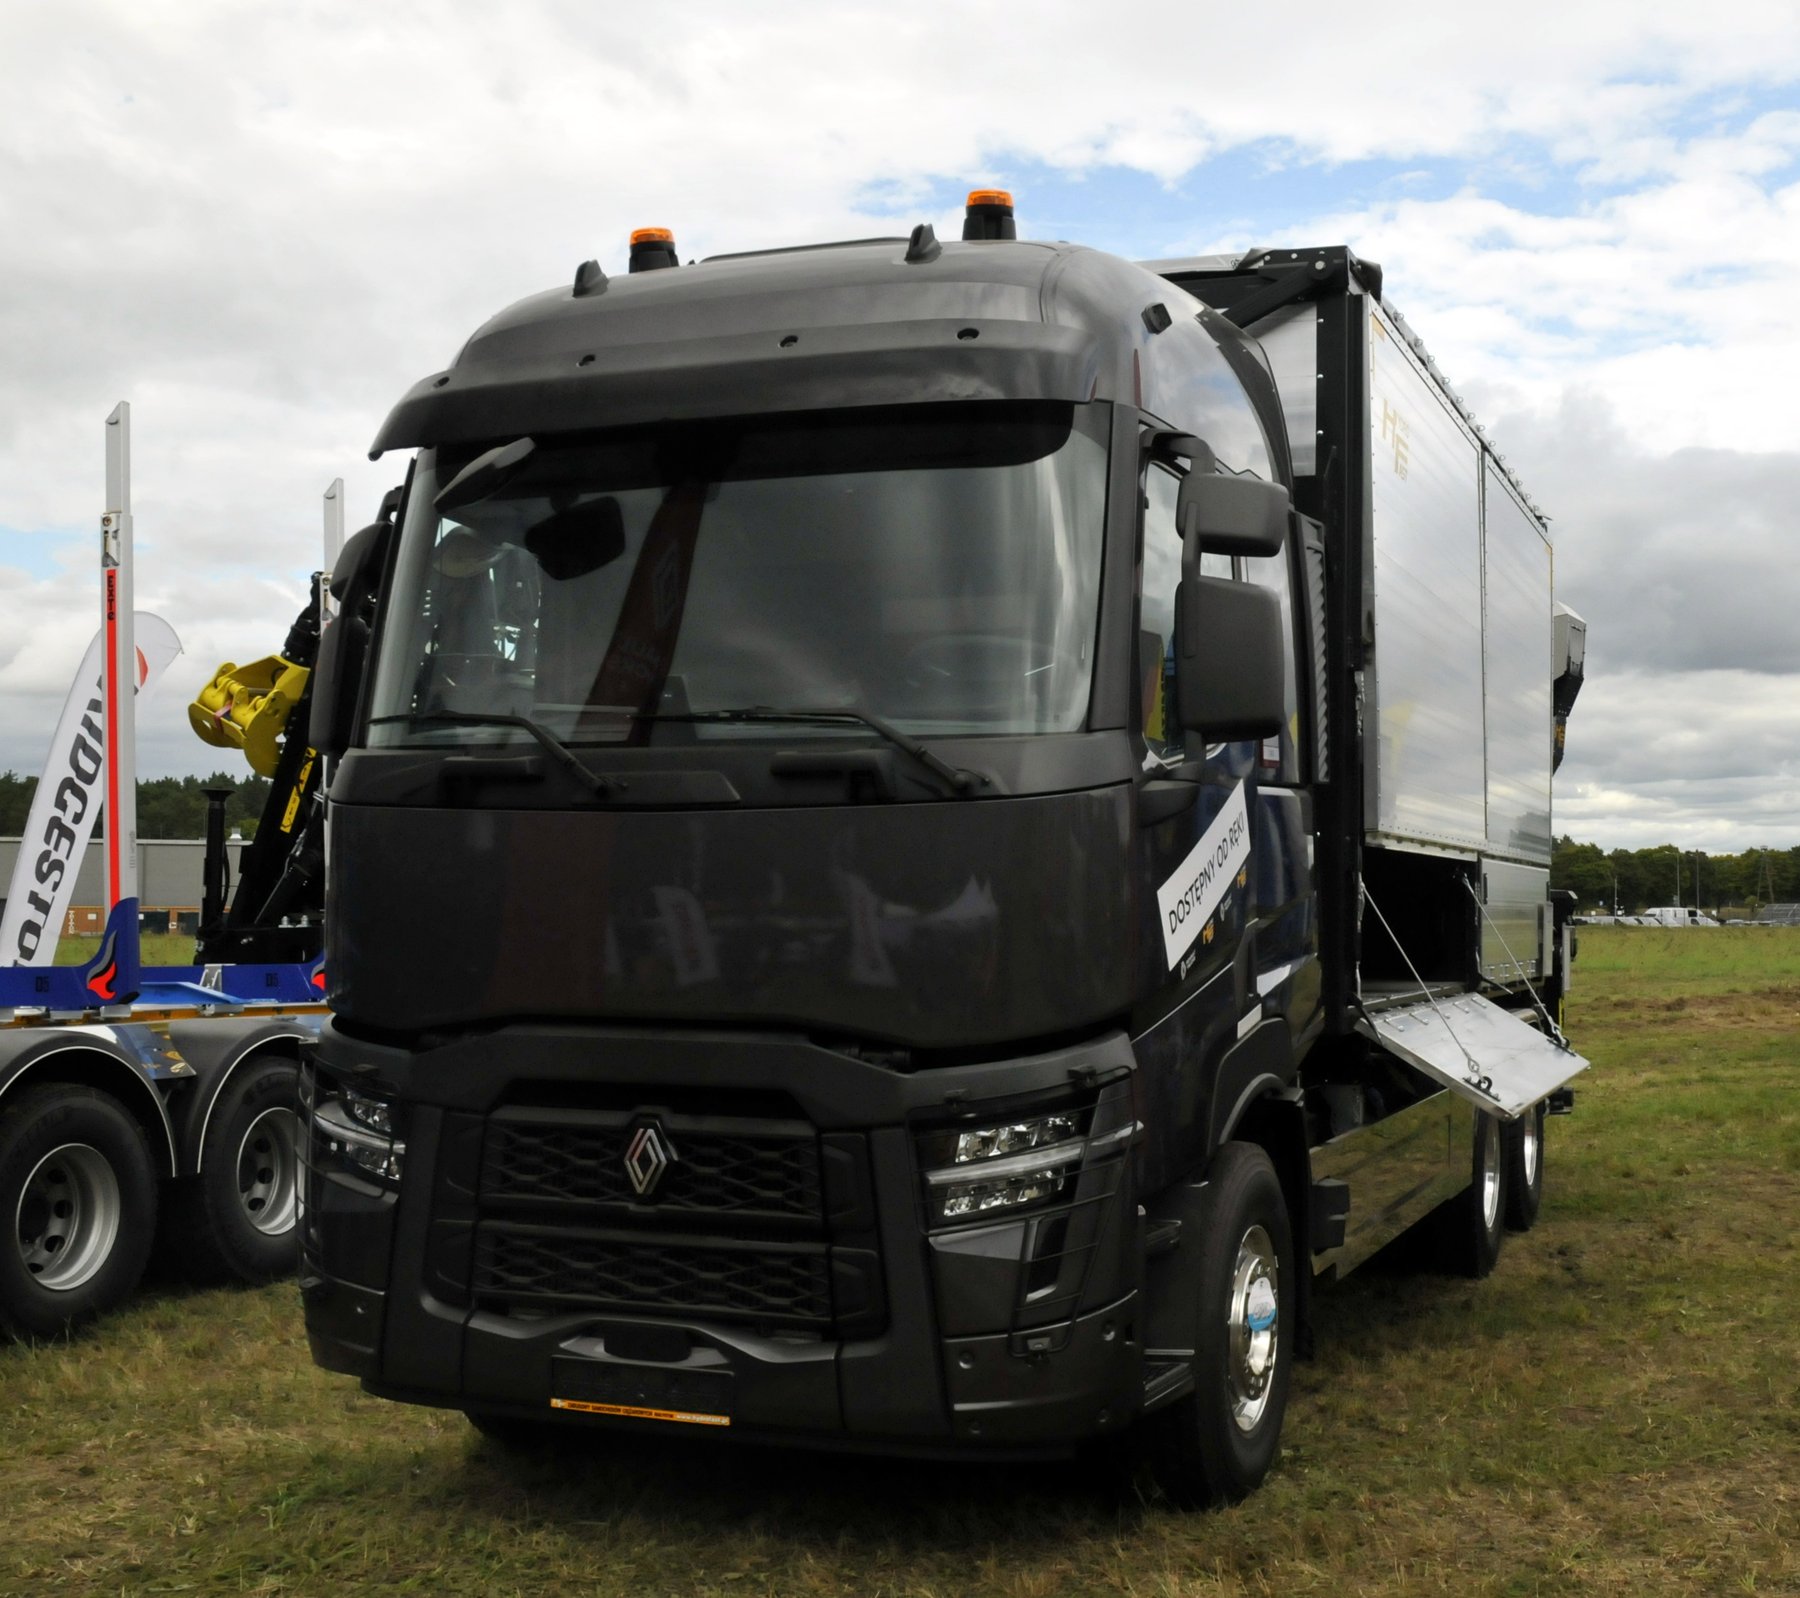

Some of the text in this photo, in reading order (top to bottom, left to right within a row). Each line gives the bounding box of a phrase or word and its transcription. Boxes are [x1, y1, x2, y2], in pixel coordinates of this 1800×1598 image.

[1168, 853, 1216, 935] DOSTĘPNY
[1216, 837, 1229, 869] OD
[1228, 811, 1245, 851] RĘKI
